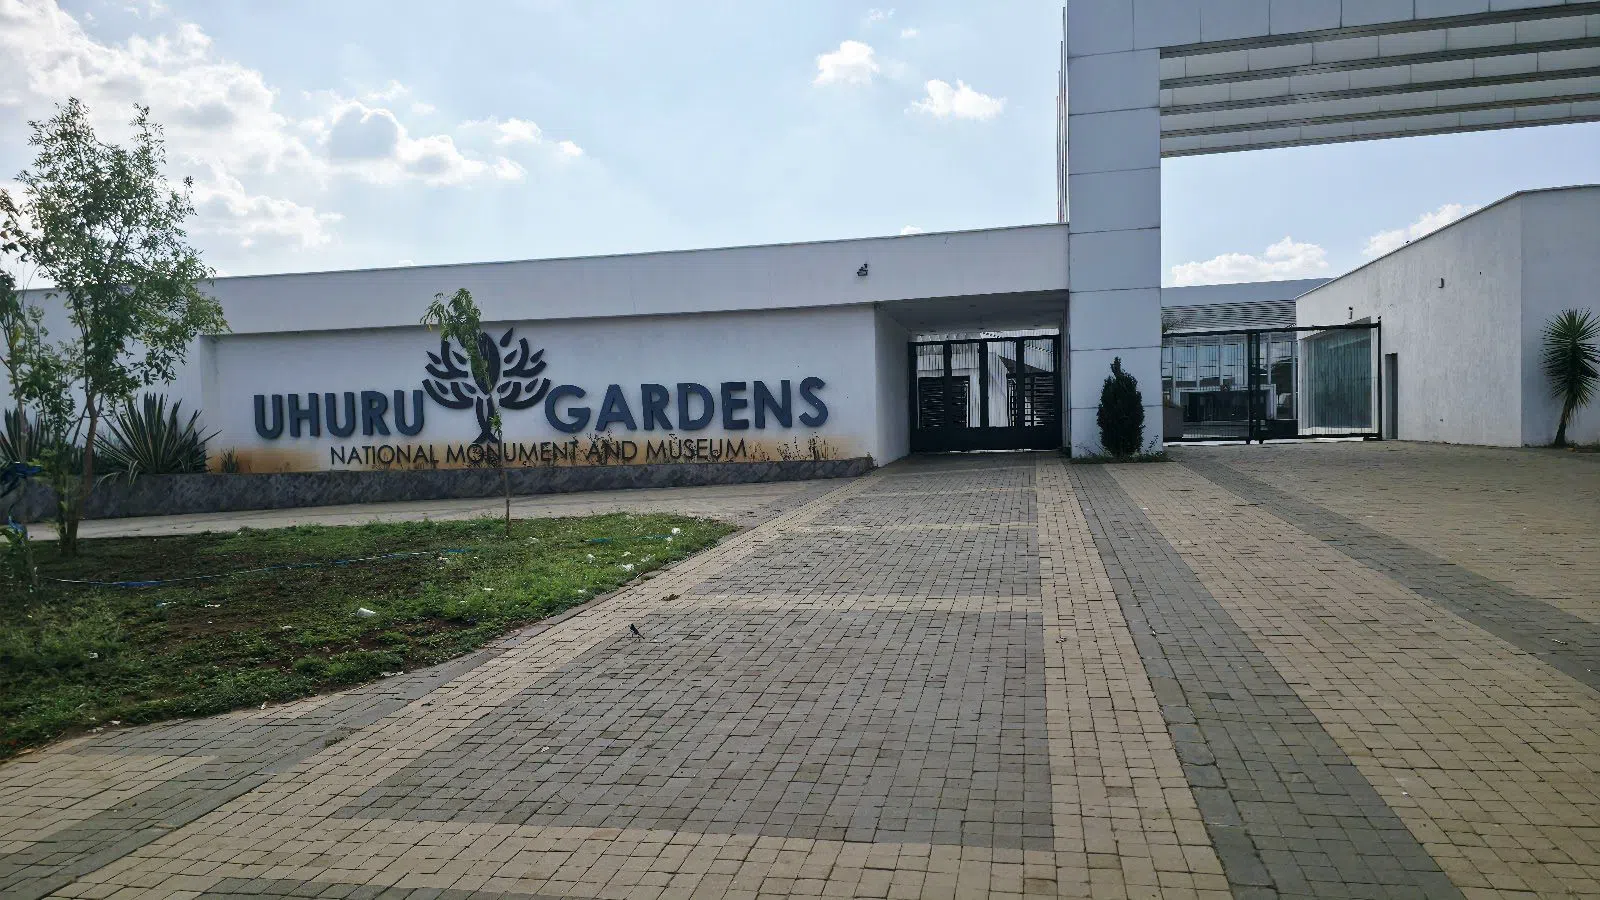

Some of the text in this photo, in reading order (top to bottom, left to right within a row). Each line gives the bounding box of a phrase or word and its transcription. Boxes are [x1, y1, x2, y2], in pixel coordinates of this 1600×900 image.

[254, 376, 829, 439] UHURU GARDENS
[330, 437, 748, 465] NATIONAL MONUMENT AND MUSEUM
